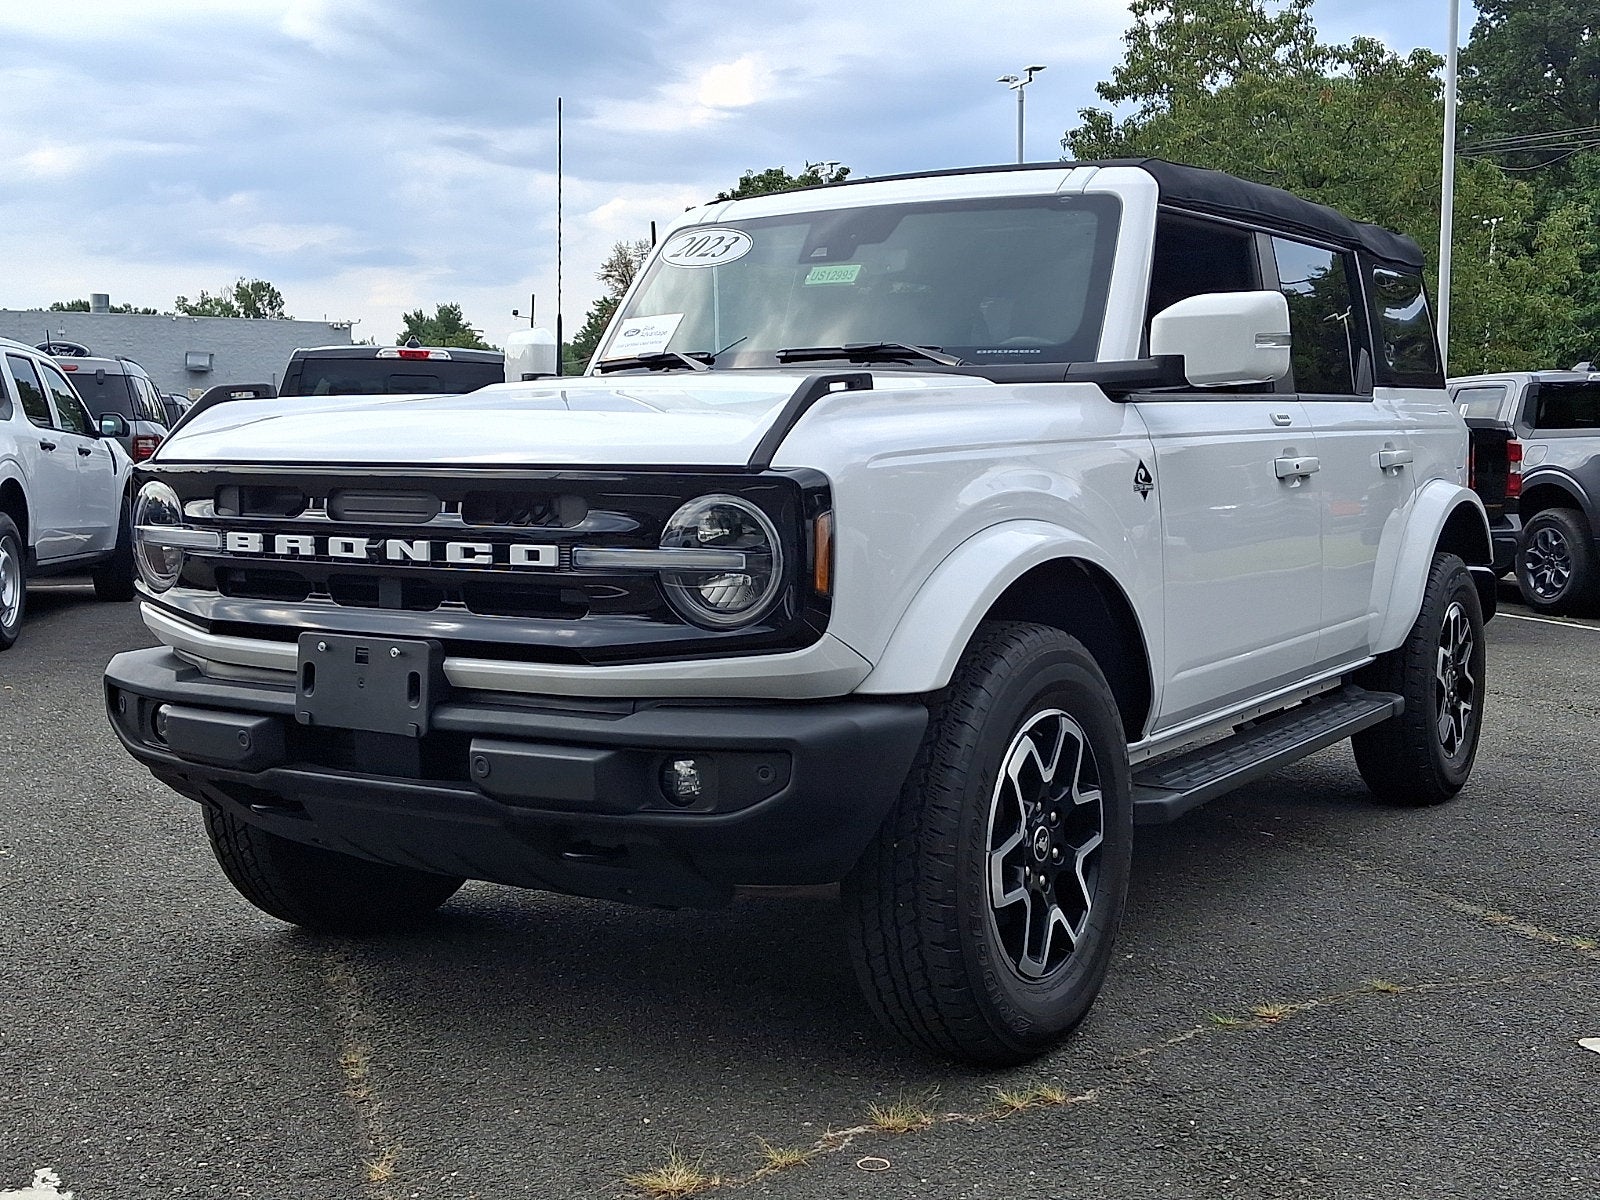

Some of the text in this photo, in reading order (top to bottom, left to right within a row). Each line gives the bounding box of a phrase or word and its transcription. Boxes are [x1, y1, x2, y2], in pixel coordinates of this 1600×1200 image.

[669, 235, 740, 258] 2023
[811, 269, 855, 281] US12995
[227, 531, 560, 567] BRONCO
